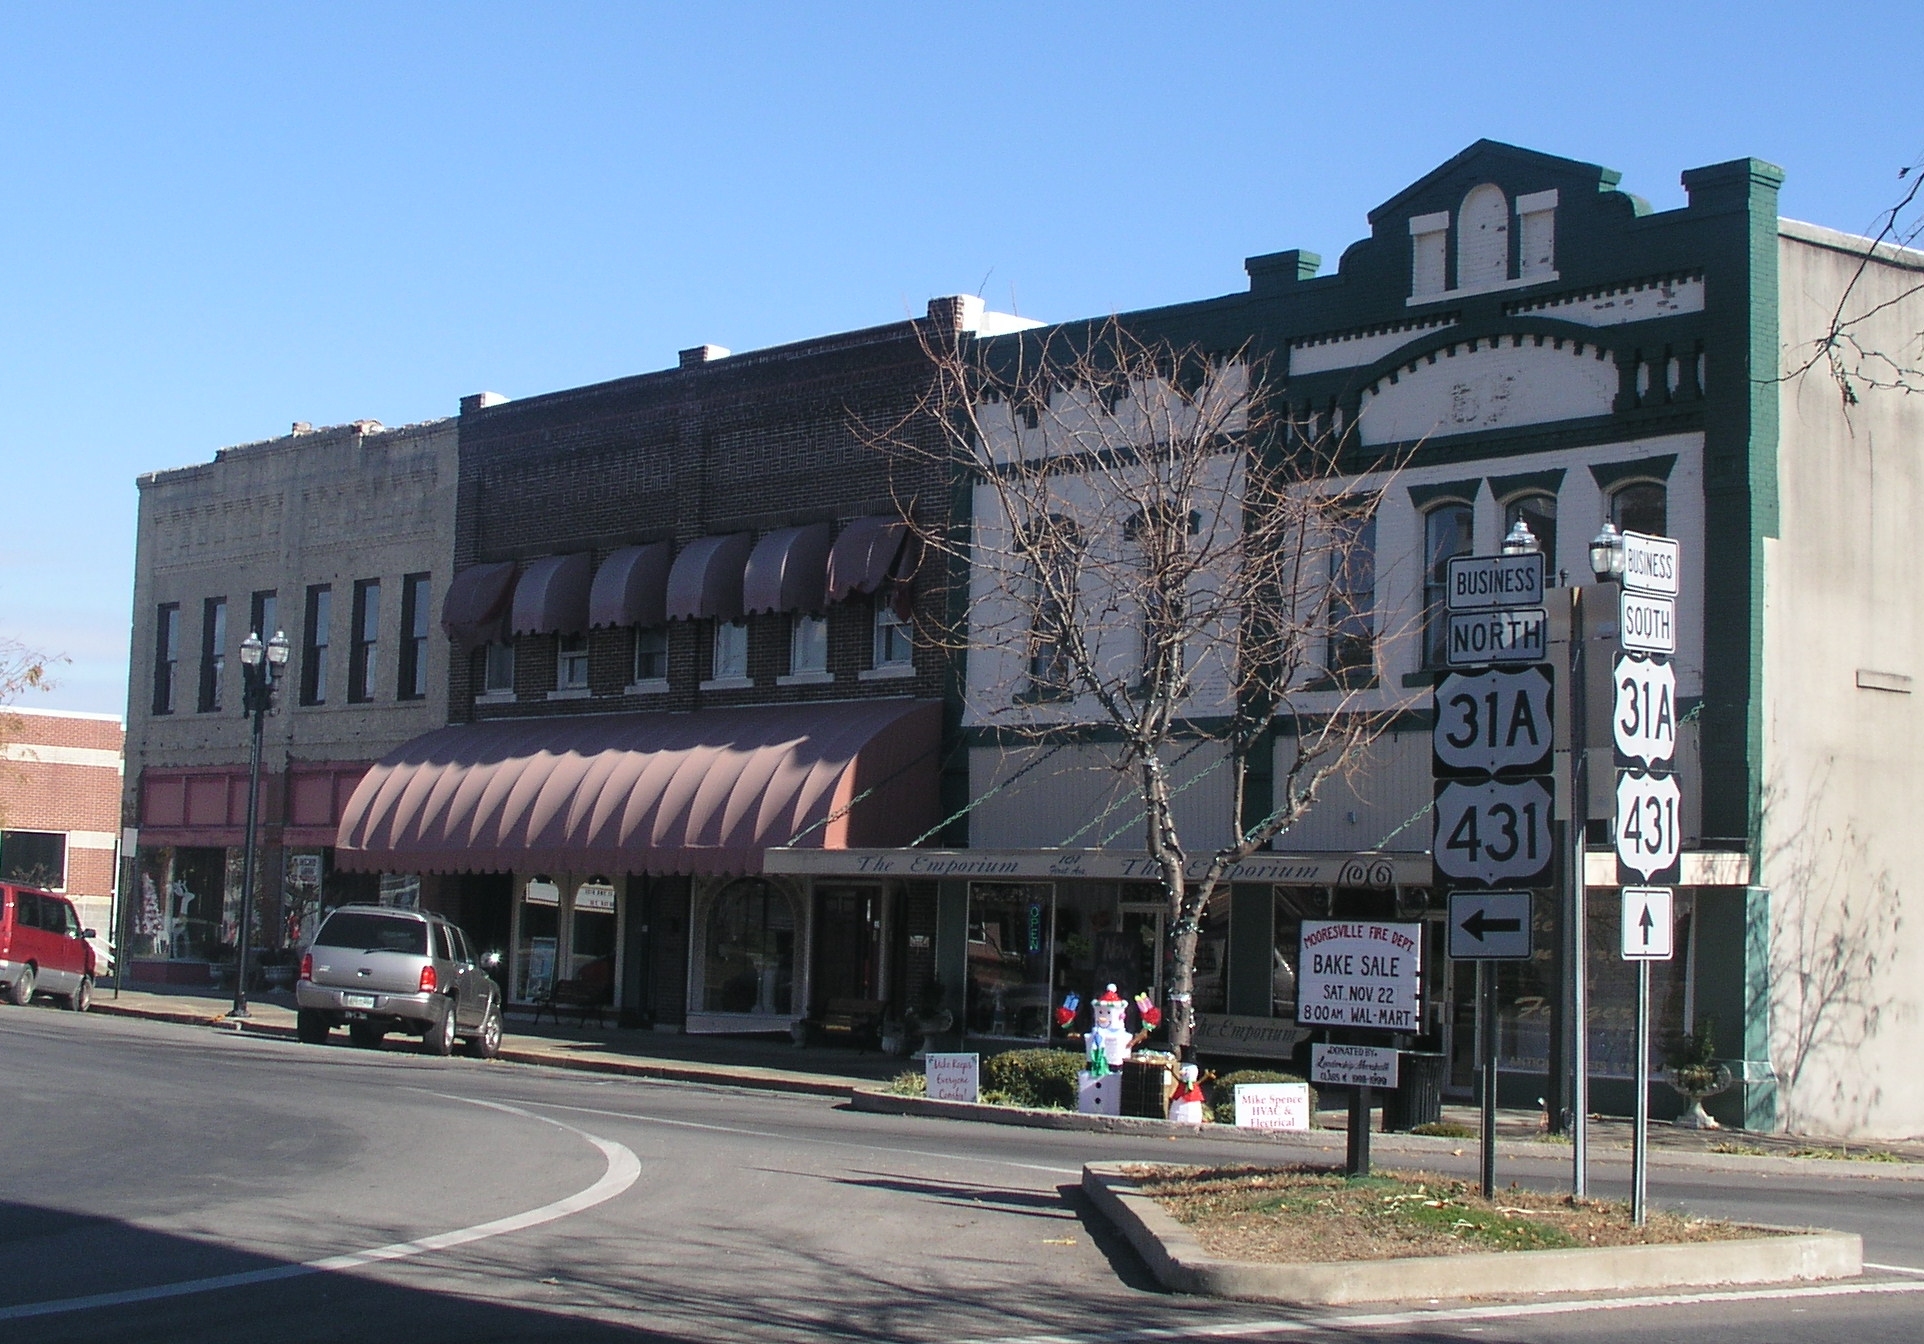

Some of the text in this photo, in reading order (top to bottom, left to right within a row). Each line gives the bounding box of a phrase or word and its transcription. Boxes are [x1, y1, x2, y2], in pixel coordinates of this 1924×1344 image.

[1627, 548, 1673, 580] BUSINESS
[1457, 567, 1535, 596] BUSINESS
[1626, 605, 1670, 639] SOUTH
[1454, 620, 1540, 653] NORTH
[1446, 689, 1539, 749] 31A
[1620, 677, 1673, 742] 31A
[1446, 802, 1537, 862] 431
[1624, 796, 1673, 855] 431
[858, 856, 1019, 875] The Emporium
[1058, 855, 1081, 864] 101
[1186, 860, 1319, 880] Eporium
[1030, 906, 1040, 950] OPEN
[1303, 924, 1363, 949] MOORESVILLE
[1369, 926, 1389, 941] FIRE
[1313, 954, 1400, 977] BAKE SALE
[1349, 986, 1374, 1002] NOV
[1377, 987, 1394, 1004] 22
[1350, 1007, 1411, 1026] WAL-MART
[1220, 1019, 1296, 1041] Emporium
[1242, 1095, 1302, 1109] Mike Spence
[1252, 1106, 1292, 1116] HVAC &
[1251, 1117, 1295, 1128] Electrical
